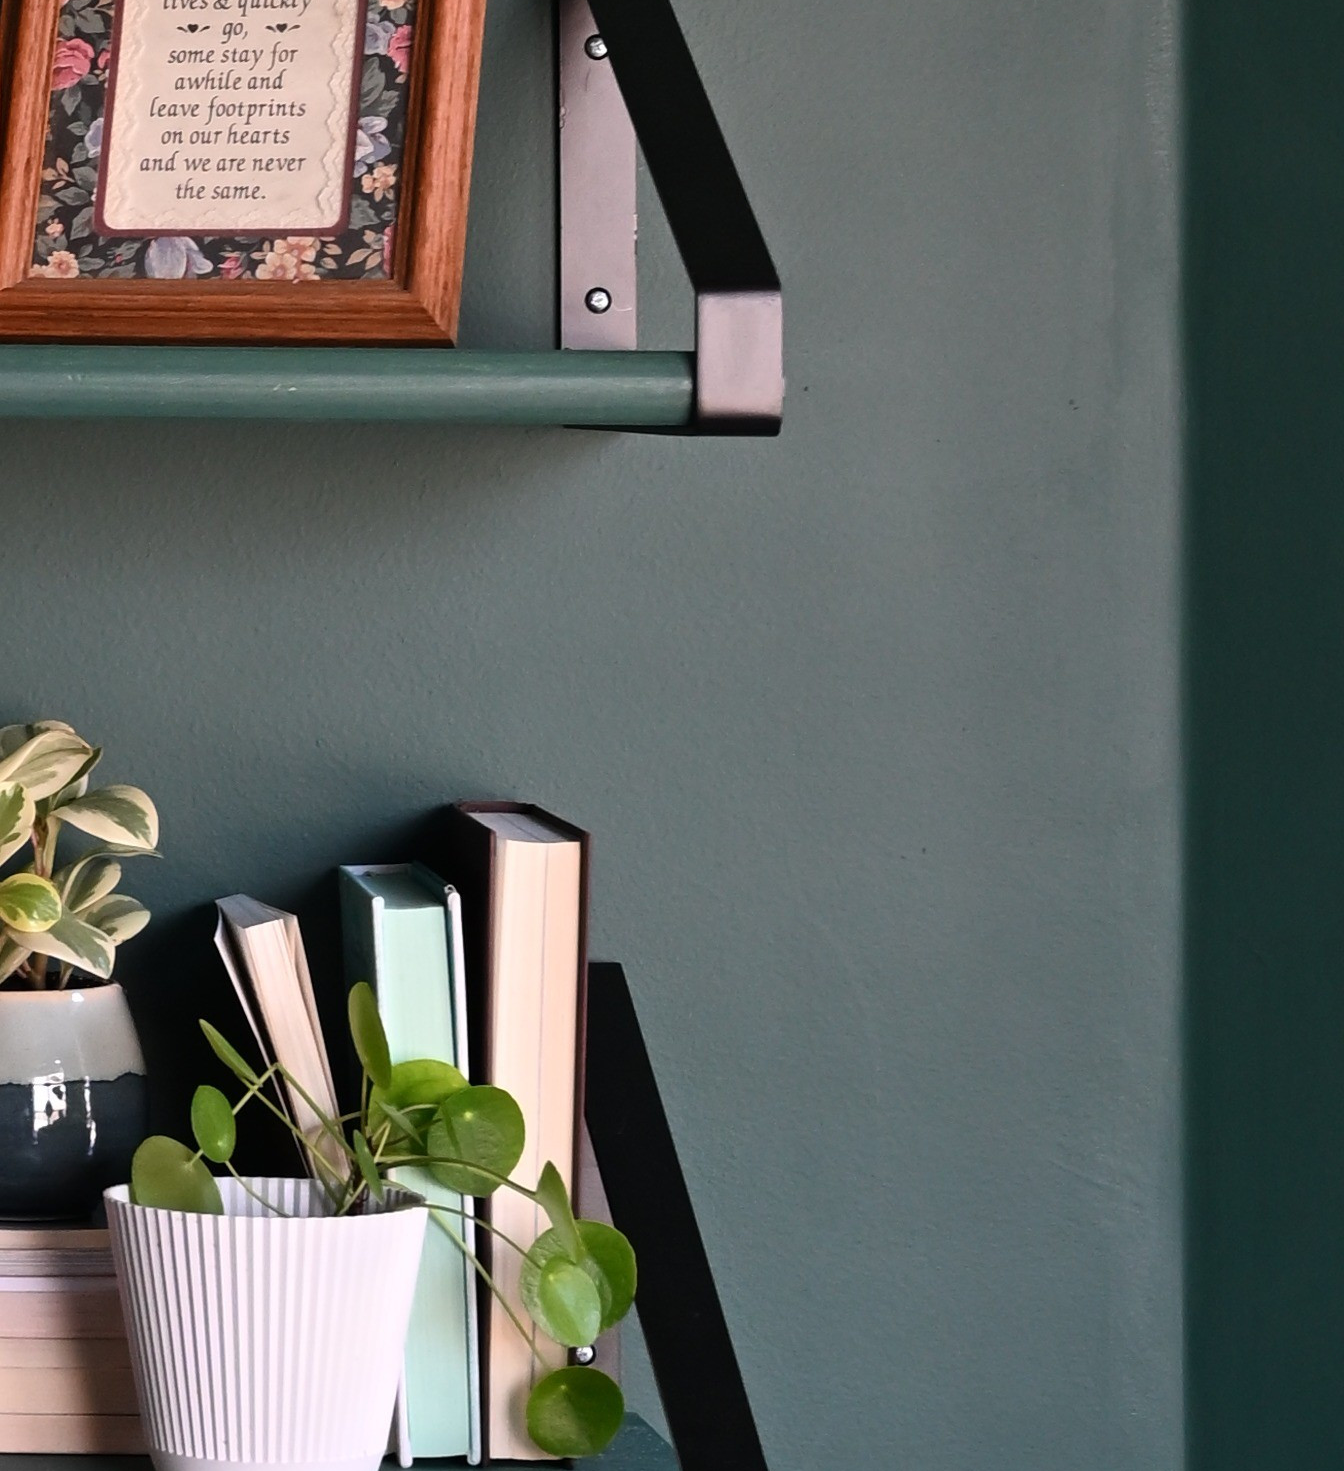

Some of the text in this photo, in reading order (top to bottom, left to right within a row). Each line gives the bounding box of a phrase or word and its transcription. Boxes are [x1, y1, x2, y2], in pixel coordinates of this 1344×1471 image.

[221, 21, 249, 44] go,
[167, 41, 299, 72] some stay for
[174, 68, 286, 91] awhile and
[149, 95, 307, 126] leave footprints
[160, 124, 291, 145] on our hearts
[139, 152, 307, 173] and we are never
[175, 179, 267, 200] the same.
